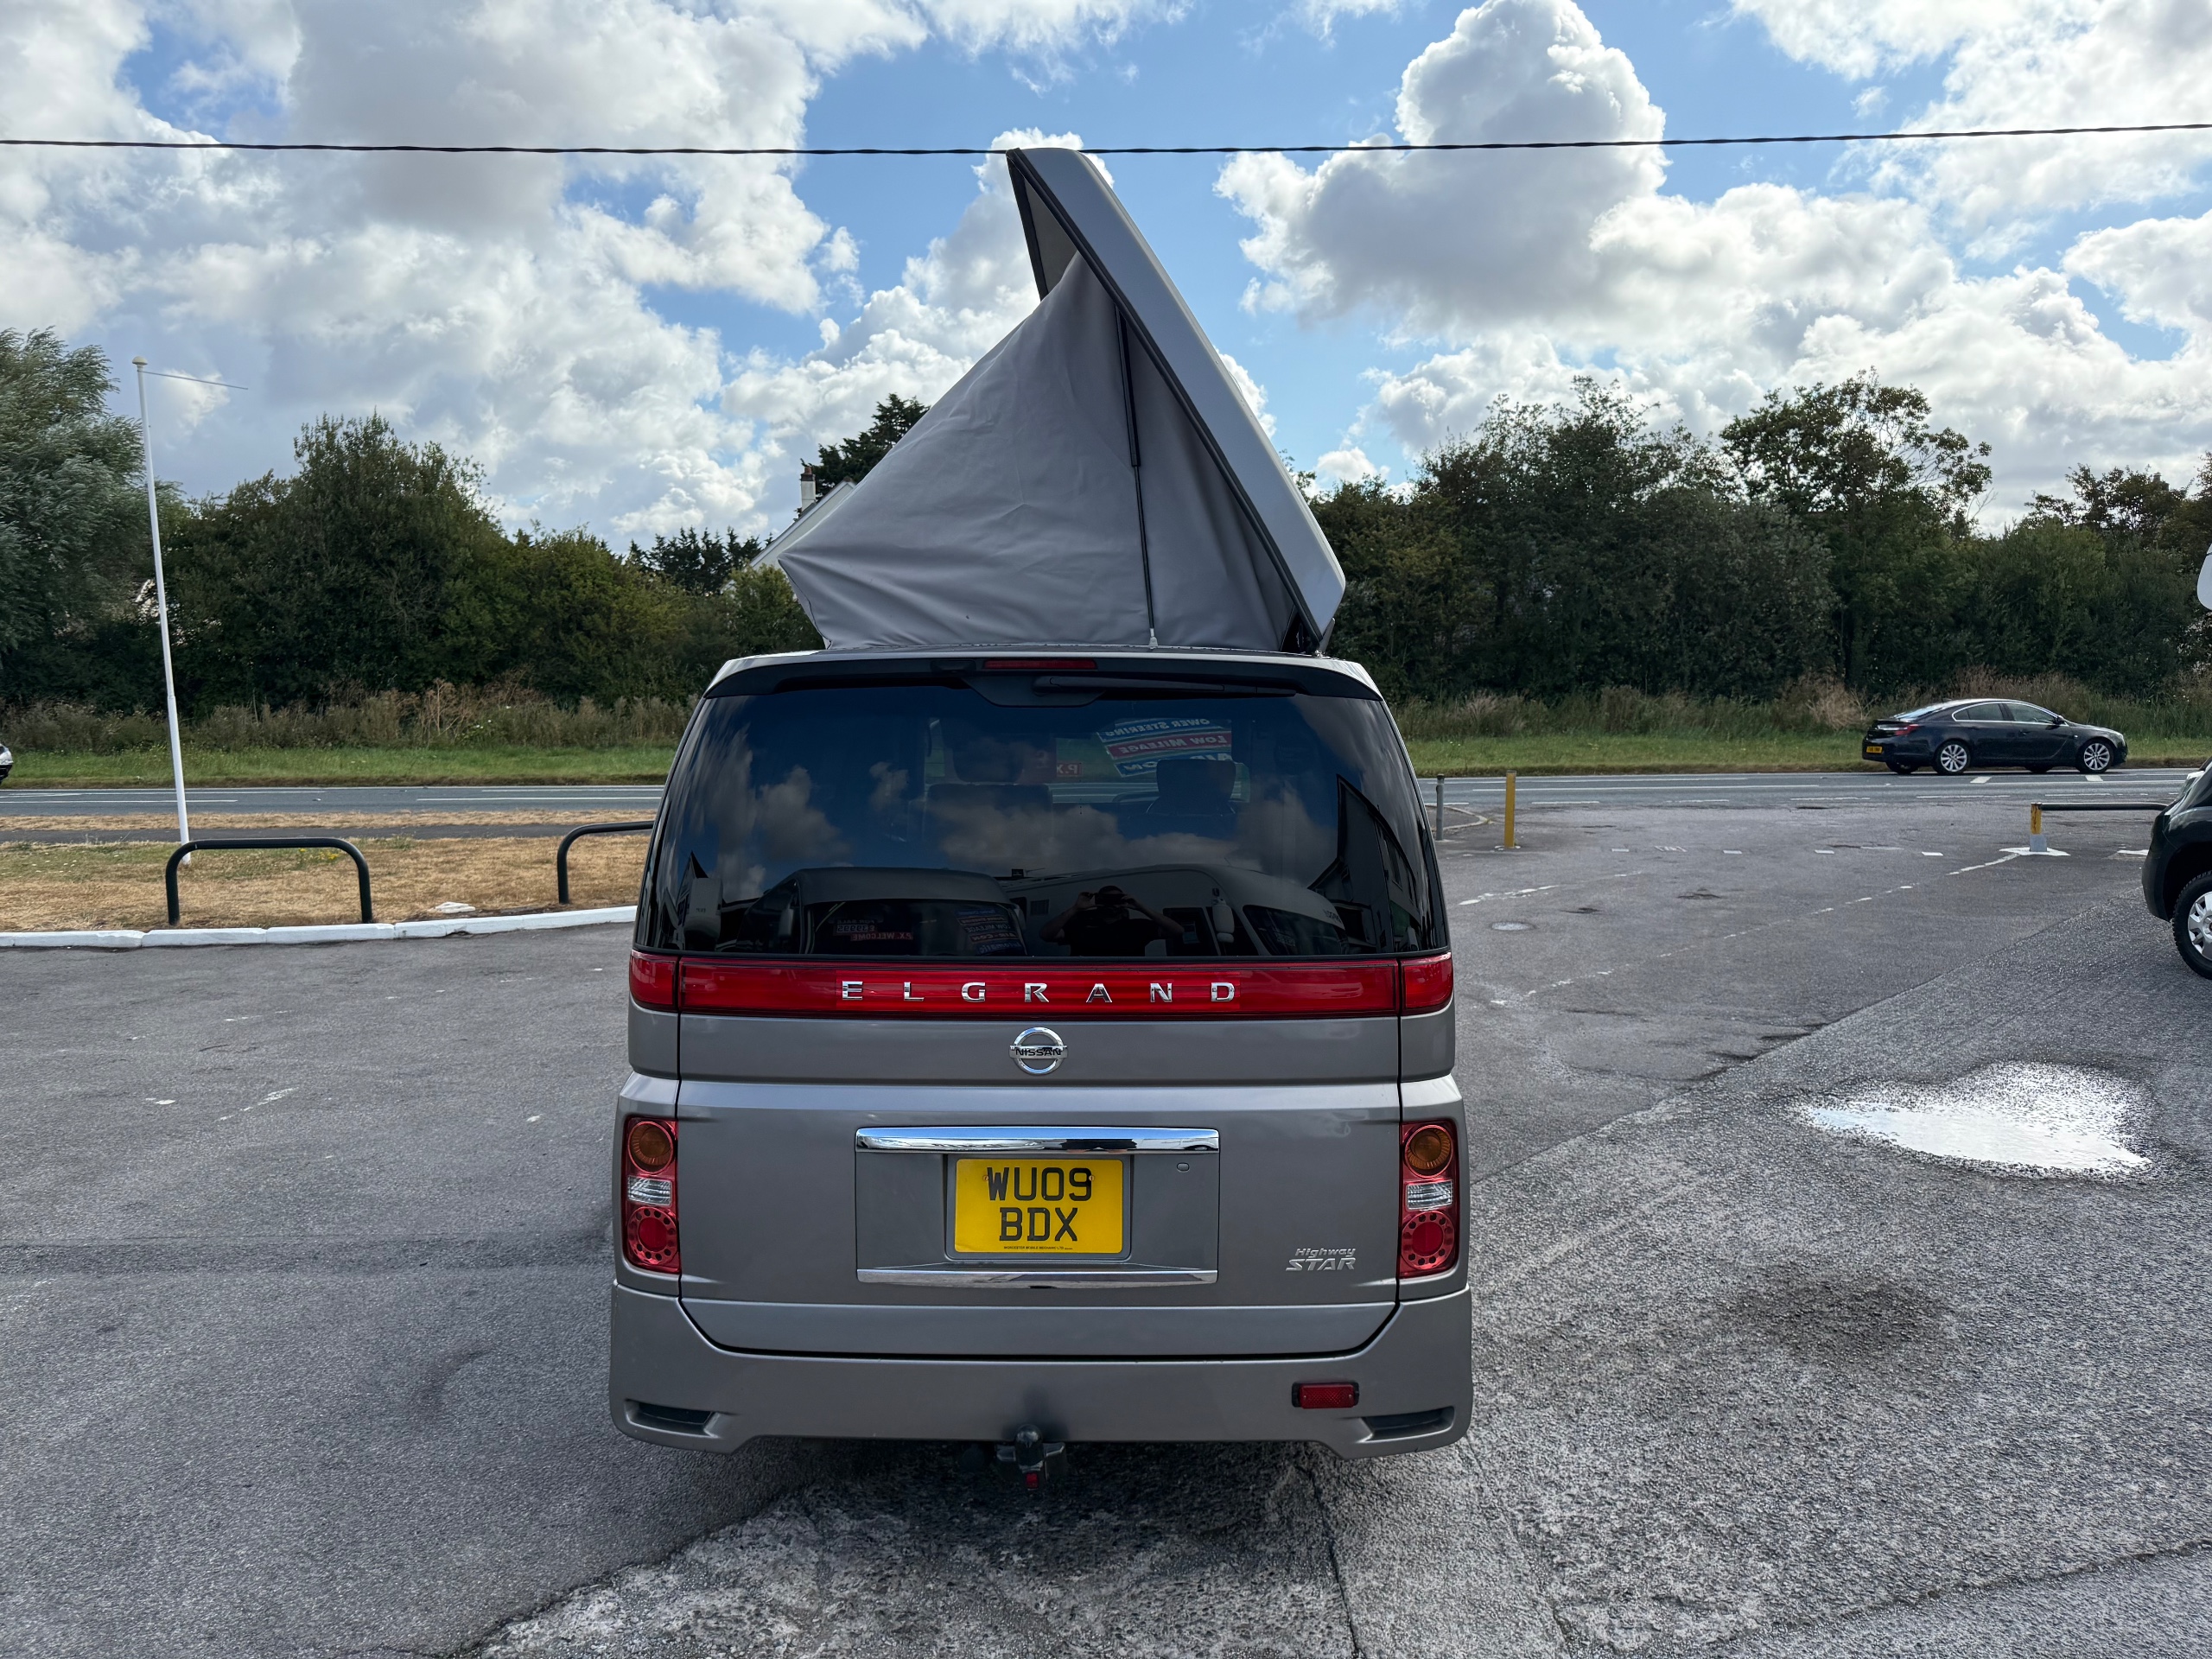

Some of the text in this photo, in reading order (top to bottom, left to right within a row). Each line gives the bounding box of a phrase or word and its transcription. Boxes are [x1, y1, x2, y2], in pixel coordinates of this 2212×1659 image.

[841, 980, 1236, 1004] ELGRAND
[1015, 1046, 1061, 1056] NISSAN
[987, 1166, 1092, 1201] WU09
[999, 1207, 1078, 1242] BDX
[1295, 1248, 1356, 1258] Highway
[1286, 1257, 1356, 1271] STAR
